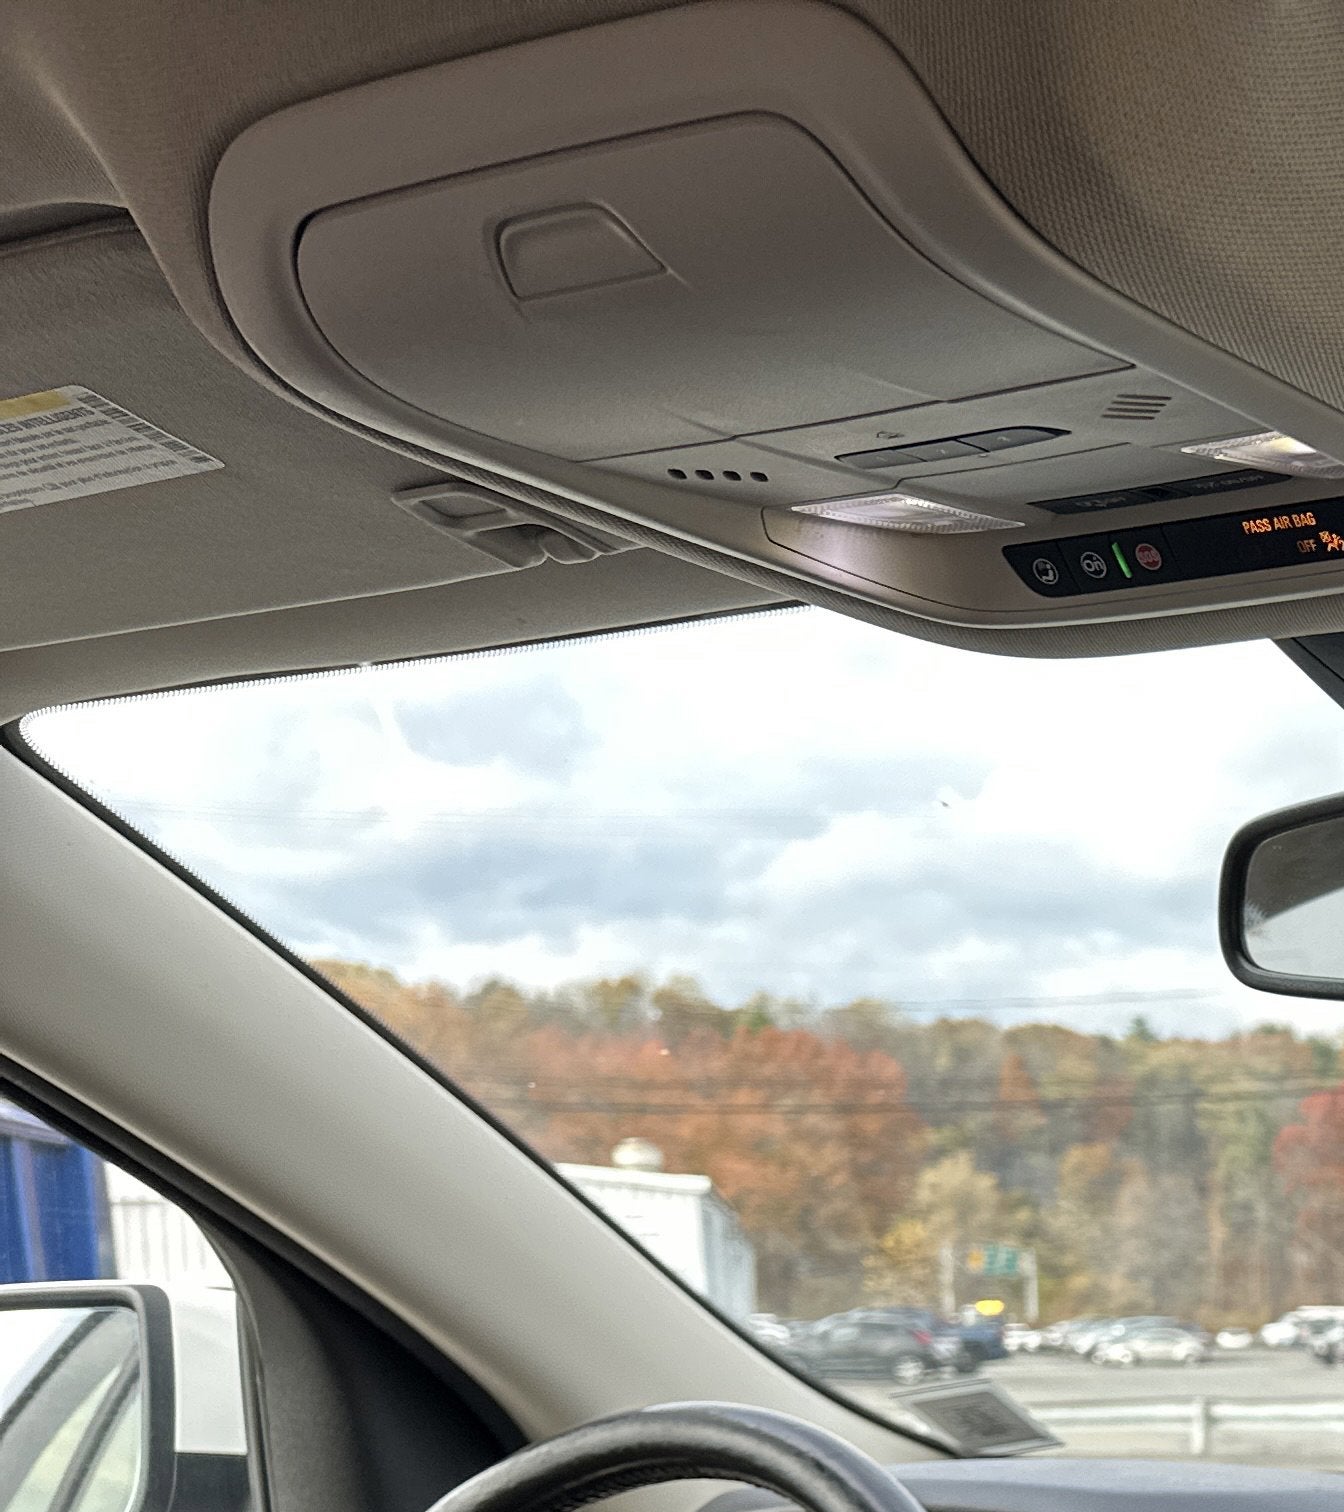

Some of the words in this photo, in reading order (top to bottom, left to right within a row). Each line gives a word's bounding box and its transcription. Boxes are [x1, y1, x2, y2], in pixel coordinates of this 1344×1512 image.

[1241, 518, 1272, 535] PASS
[1273, 515, 1293, 531] AIR
[1291, 511, 1317, 528] BAG
[1296, 538, 1317, 553] OFF
